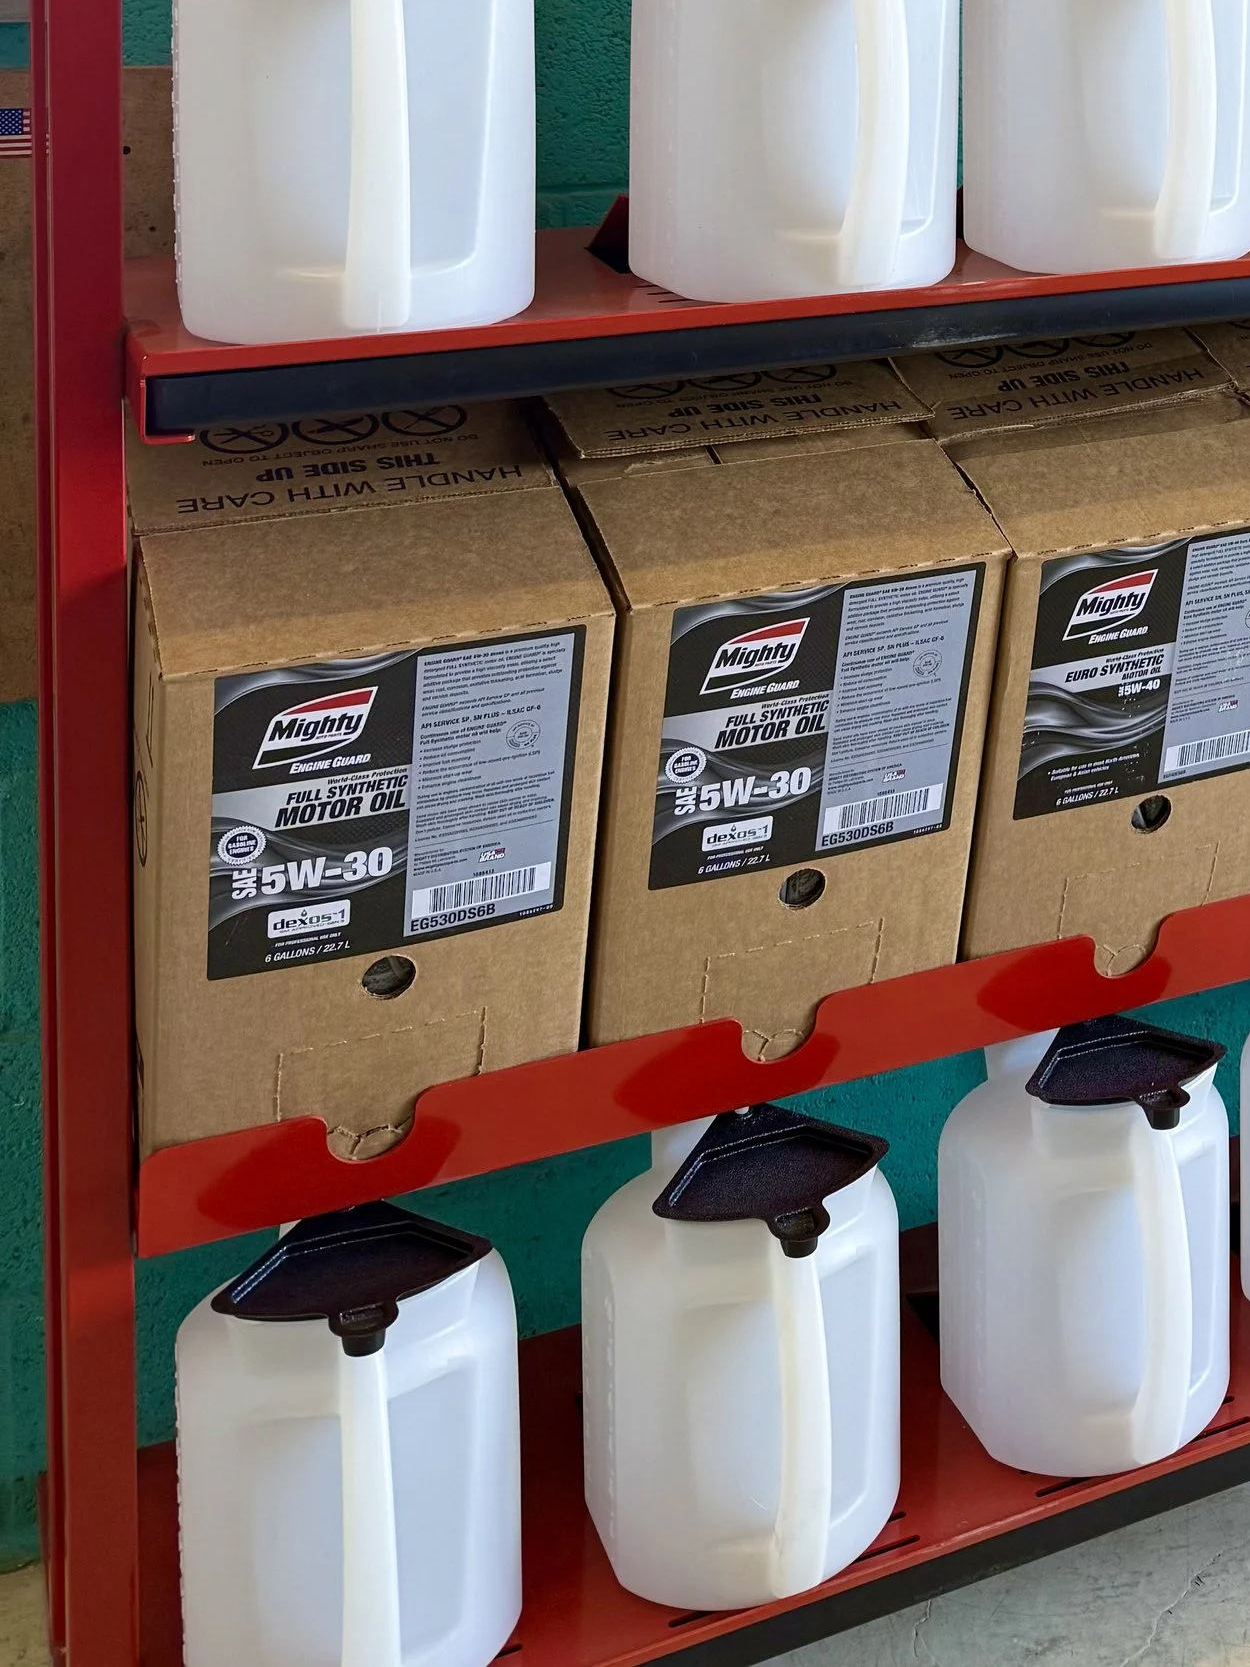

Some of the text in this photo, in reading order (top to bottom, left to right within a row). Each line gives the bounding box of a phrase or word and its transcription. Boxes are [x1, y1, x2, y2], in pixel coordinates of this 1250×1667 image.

[256, 453, 440, 482] THIS SIDE UP
[176, 465, 523, 514] HANDLE WITH CARE
[1076, 591, 1146, 616] Mighty
[1089, 626, 1148, 644] ENGINE GUARD
[715, 642, 797, 669] Mighty
[1065, 654, 1164, 683] EURO SYNTHETIC
[1122, 666, 1161, 680] MOTOR OIL
[730, 680, 799, 699] ENGINE GUARD
[1124, 679, 1160, 695] 5W-40
[268, 713, 363, 742] Mighty
[725, 700, 829, 728] FULL SYNTHETIC
[715, 714, 825, 749] MOTOR OIL
[289, 754, 371, 774] ENGINE GUARD
[327, 768, 407, 785] World-Class Protection
[286, 775, 408, 805] FULL SYNTHETIC
[675, 767, 812, 815] SAE 5W-30
[275, 790, 405, 828] MOTOR OIL
[227, 839, 256, 847] GASOLINE
[821, 822, 894, 847] EG530DS6B
[232, 846, 393, 899] SAE 5W-30
[411, 903, 495, 932] EG530DS6B
[265, 954, 271, 962] 6
[274, 947, 315, 962] GALLONS
[324, 942, 344, 953] 22.7
